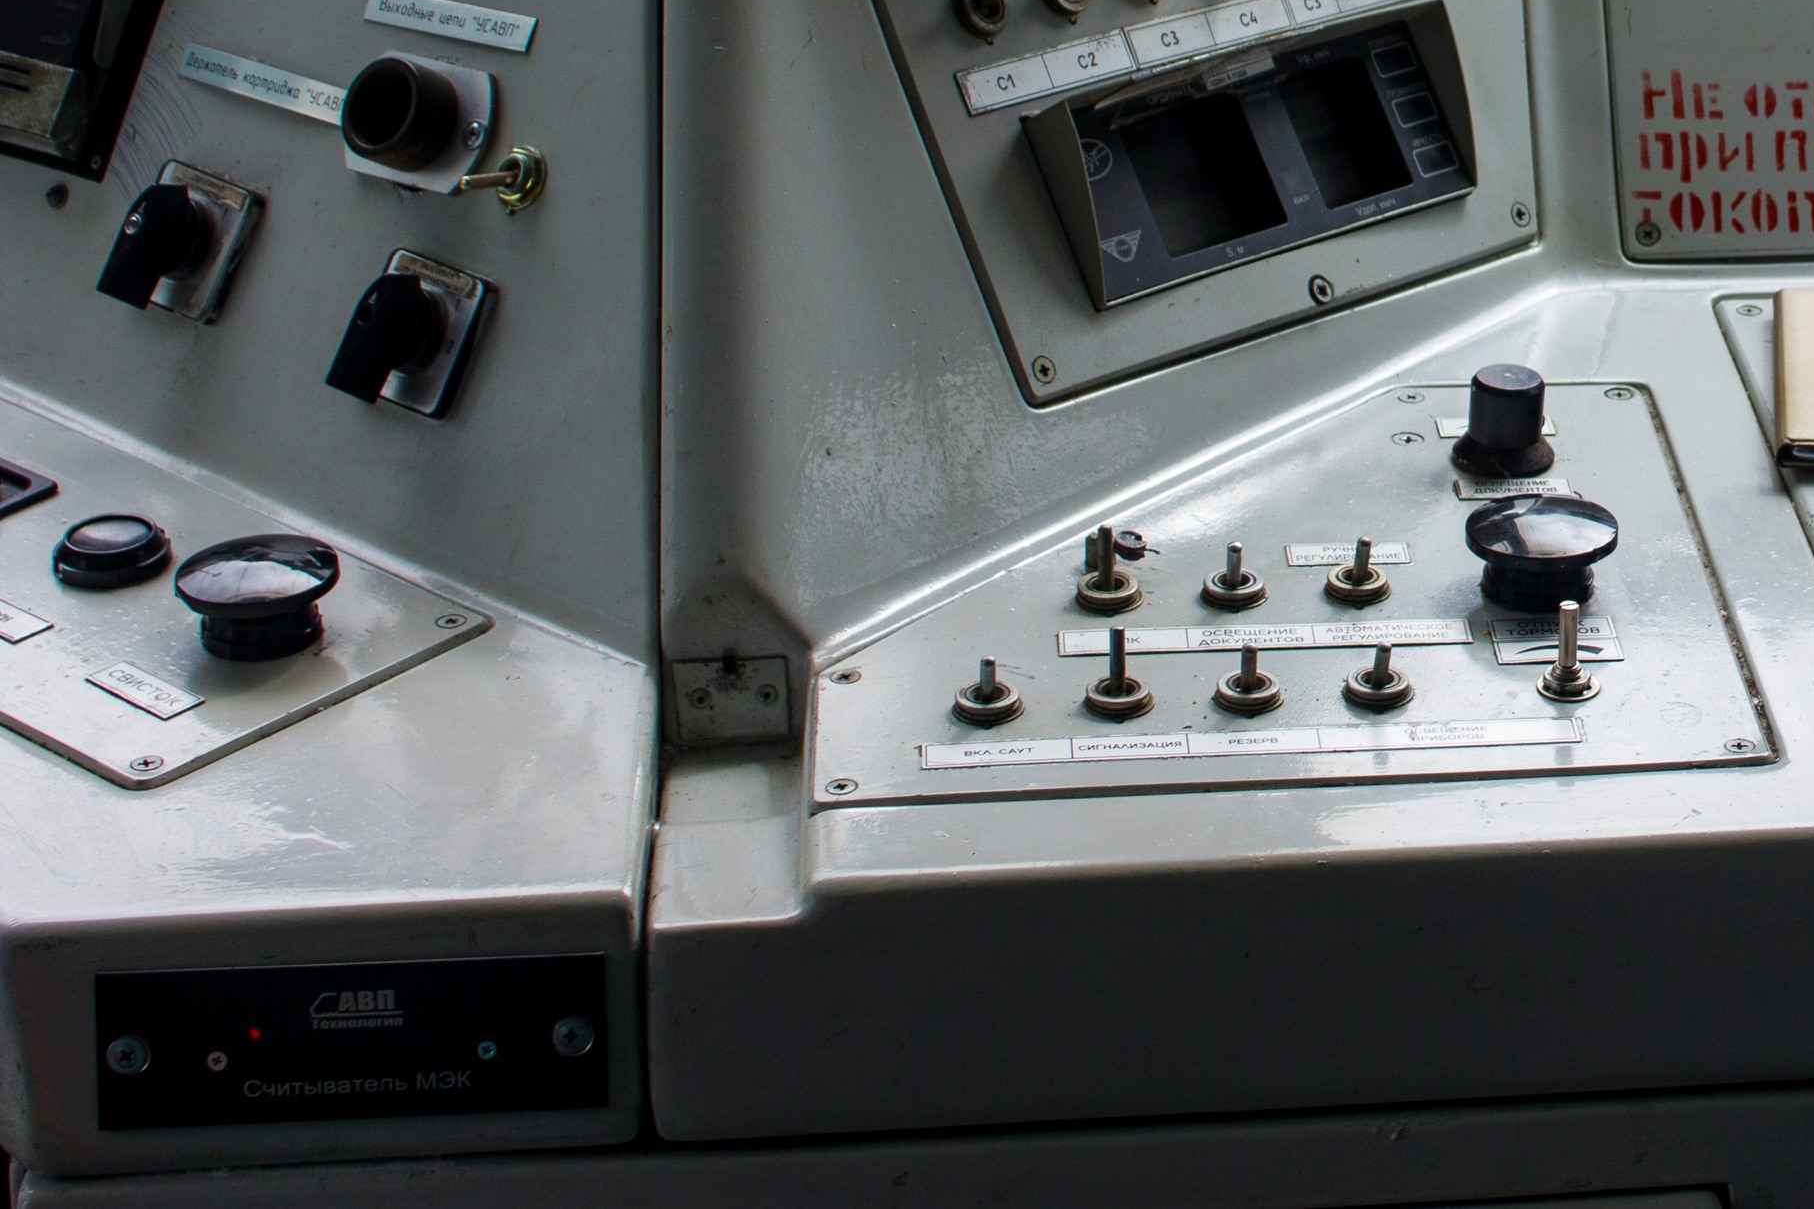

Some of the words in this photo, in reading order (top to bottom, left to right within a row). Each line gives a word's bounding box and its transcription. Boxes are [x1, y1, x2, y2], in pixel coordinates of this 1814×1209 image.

[438, 10, 467, 29] цепи
[1239, 10, 1260, 29] С4
[1160, 30, 1180, 48] С3
[1077, 51, 1098, 70] С2
[185, 50, 239, 80] Держатель
[242, 69, 301, 100] картриджа
[996, 73, 1015, 92] С1
[1474, 486, 1558, 494] ДОКУМЕНТОВ
[1201, 626, 1299, 638] ОСВЕЩЕНИЕ
[1325, 621, 1455, 634] АВТОМАТИЧЕСКОЕ
[1197, 635, 1306, 647] ДОКУМЕНТОВ
[1331, 630, 1450, 642] РЕГУЛИРОВАНИЕ
[108, 668, 184, 708] СВИСТОК
[1404, 725, 1488, 735] ОСВЕЩЕНИЕ
[1227, 736, 1279, 746] РЕЗЕРВ
[1411, 732, 1486, 742] ПРИБОРОВ
[998, 746, 1035, 756] САУТ
[1077, 739, 1184, 753] СИГНАЛИЗАЦИЯ
[337, 989, 396, 1012] АВП
[311, 1017, 404, 1030] Технология
[242, 1076, 409, 1099] Считыватель
[415, 1069, 473, 1091] МЭК
